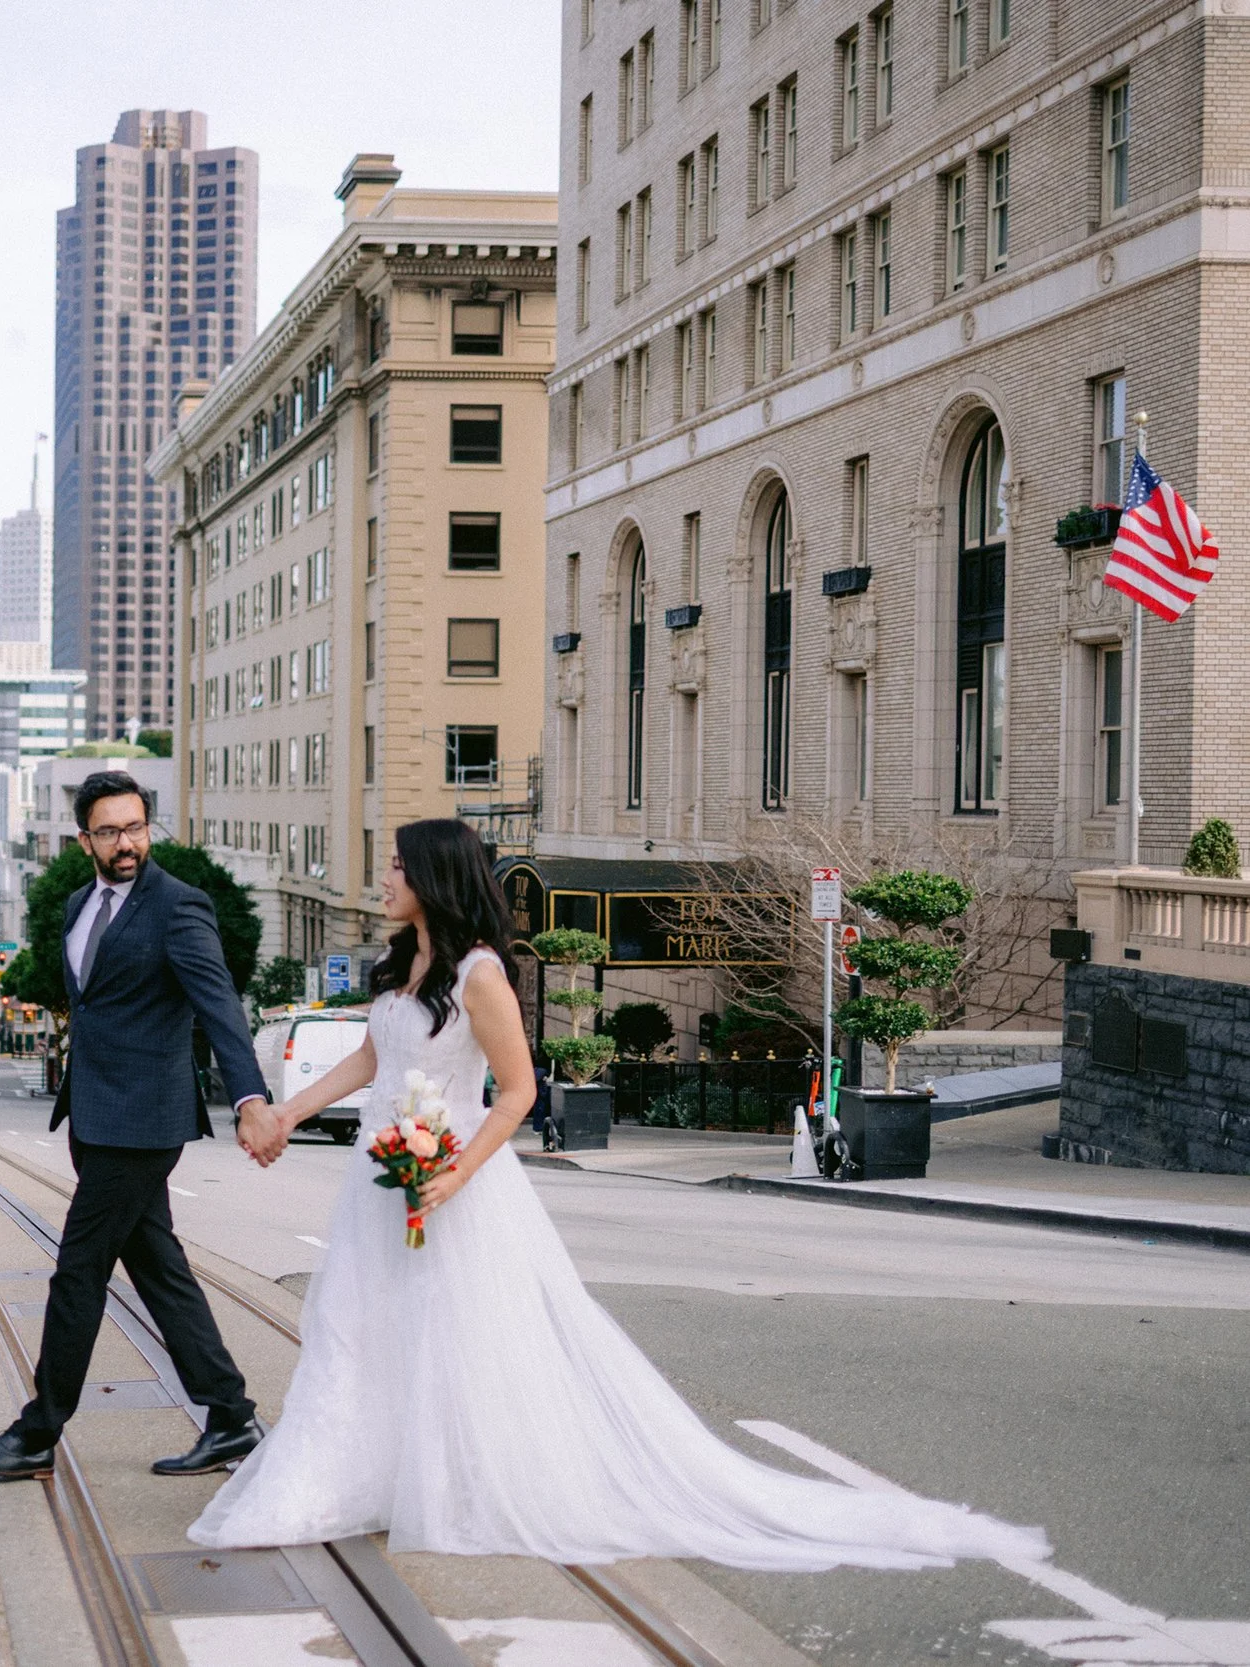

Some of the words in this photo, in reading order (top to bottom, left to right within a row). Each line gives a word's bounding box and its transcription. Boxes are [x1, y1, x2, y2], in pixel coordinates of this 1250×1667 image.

[514, 875, 529, 897] TOP
[673, 897, 721, 921] TOP
[666, 935, 730, 958] MARK
